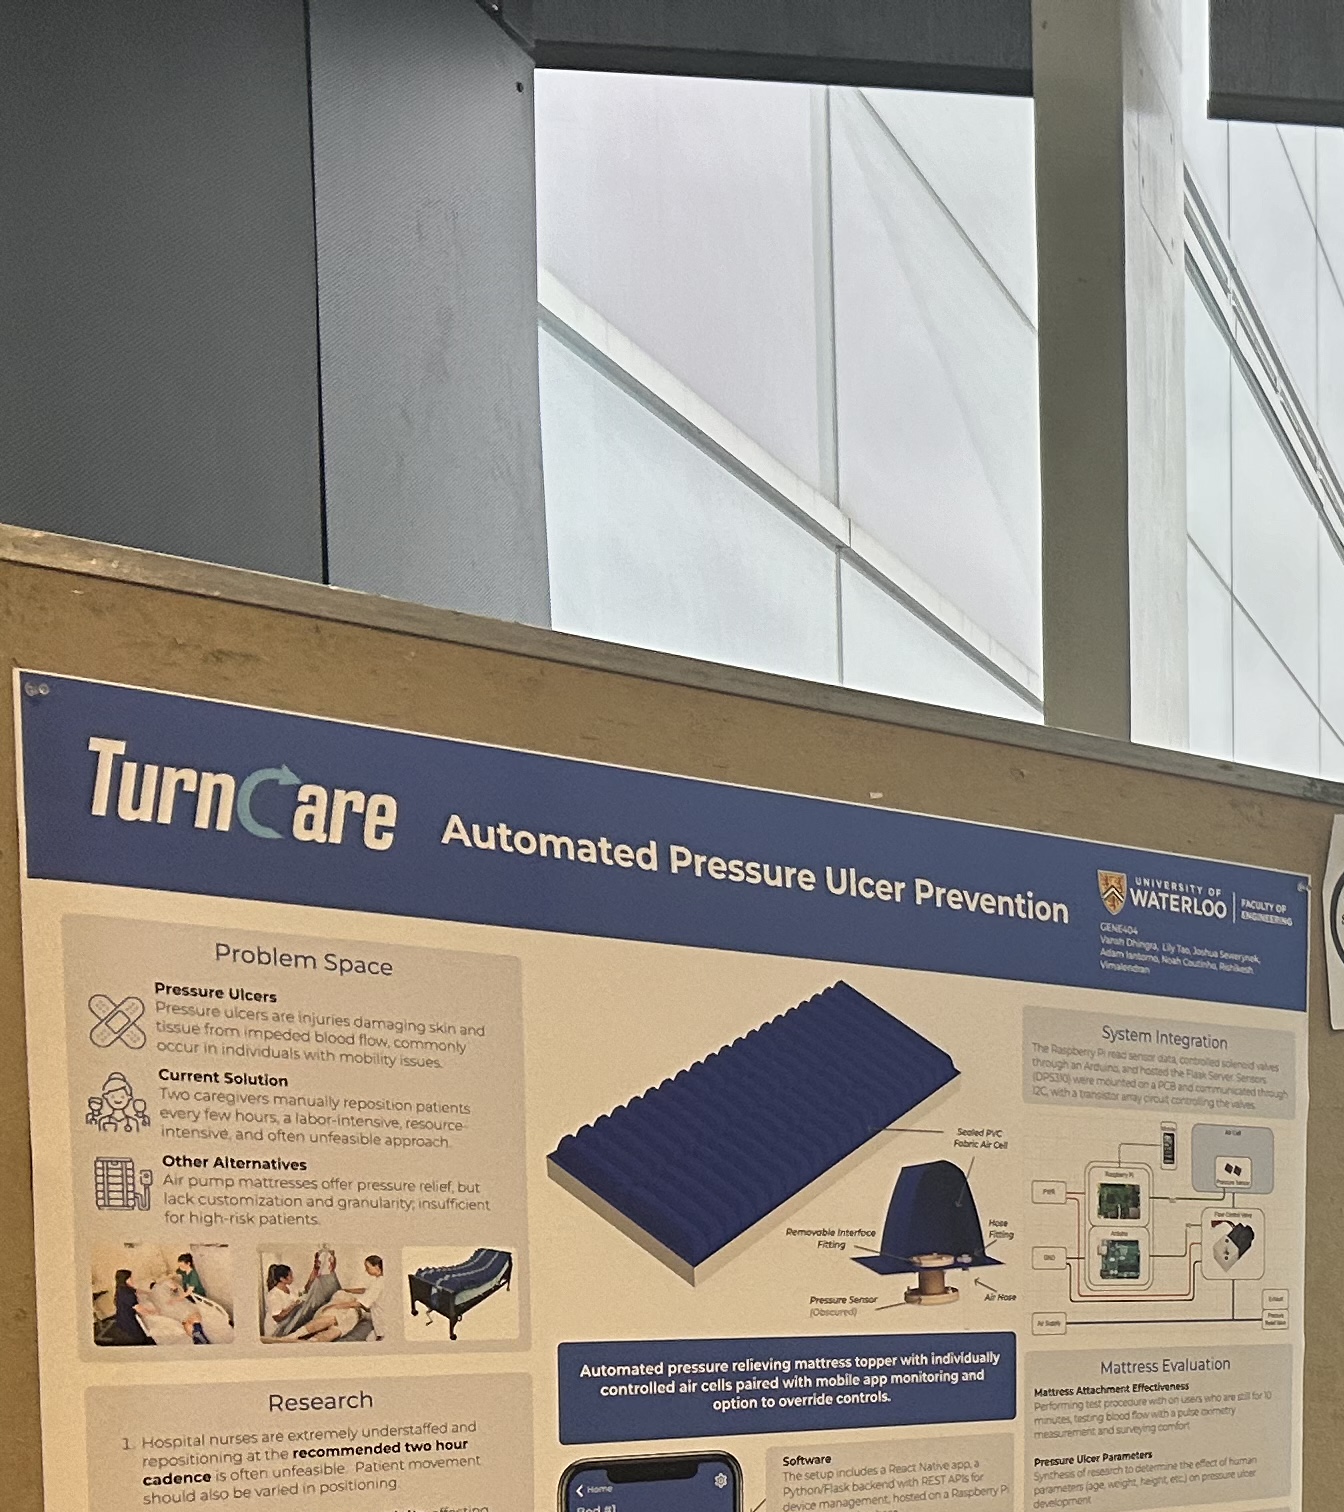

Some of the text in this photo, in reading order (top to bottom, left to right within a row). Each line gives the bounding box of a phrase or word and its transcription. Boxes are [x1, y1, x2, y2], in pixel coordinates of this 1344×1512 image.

[88, 736, 398, 851] TurnCare
[441, 815, 1069, 925] Automated Pressure Ulcer Prevention
[1135, 877, 1222, 897] UNIVERSITY OF
[1129, 888, 1227, 919] WATERLOO
[1241, 899, 1287, 913] FACULTY OF
[215, 943, 393, 977] Problem Space
[154, 982, 277, 1002] Pressure Ulcers
[155, 1002, 485, 1036] Pressure ulcers are injuries damaging skin and
[1102, 1026, 1228, 1049] System Integration
[158, 1069, 288, 1087] Current Solution
[954, 1140, 1008, 1149] Fabric Air Cell
[162, 1155, 307, 1171] Other Alternatives
[989, 1219, 1008, 1227] Hose
[786, 1228, 876, 1237] Removable Interface
[989, 1231, 1014, 1240] Fitting
[818, 1241, 846, 1250] Fitting
[810, 1296, 878, 1305] Pressure Sensor
[998, 1293, 1017, 1301] Hose
[810, 1308, 857, 1317] (Obscured)
[580, 1351, 1000, 1377] Automated pressure relieving mattress topper with individually
[1100, 1357, 1231, 1375] Mattress Evaluation
[600, 1369, 985, 1395] controlled air cells paired with mobile app monitoring and
[1034, 1383, 1190, 1397] Mattress Attachment Effectiveness
[268, 1392, 374, 1412] Research
[713, 1391, 892, 1414] option to override controls.
[782, 1454, 832, 1466] Software
[1034, 1451, 1153, 1467] Pressure Ulcer Parameters
[587, 1485, 613, 1493] Home
